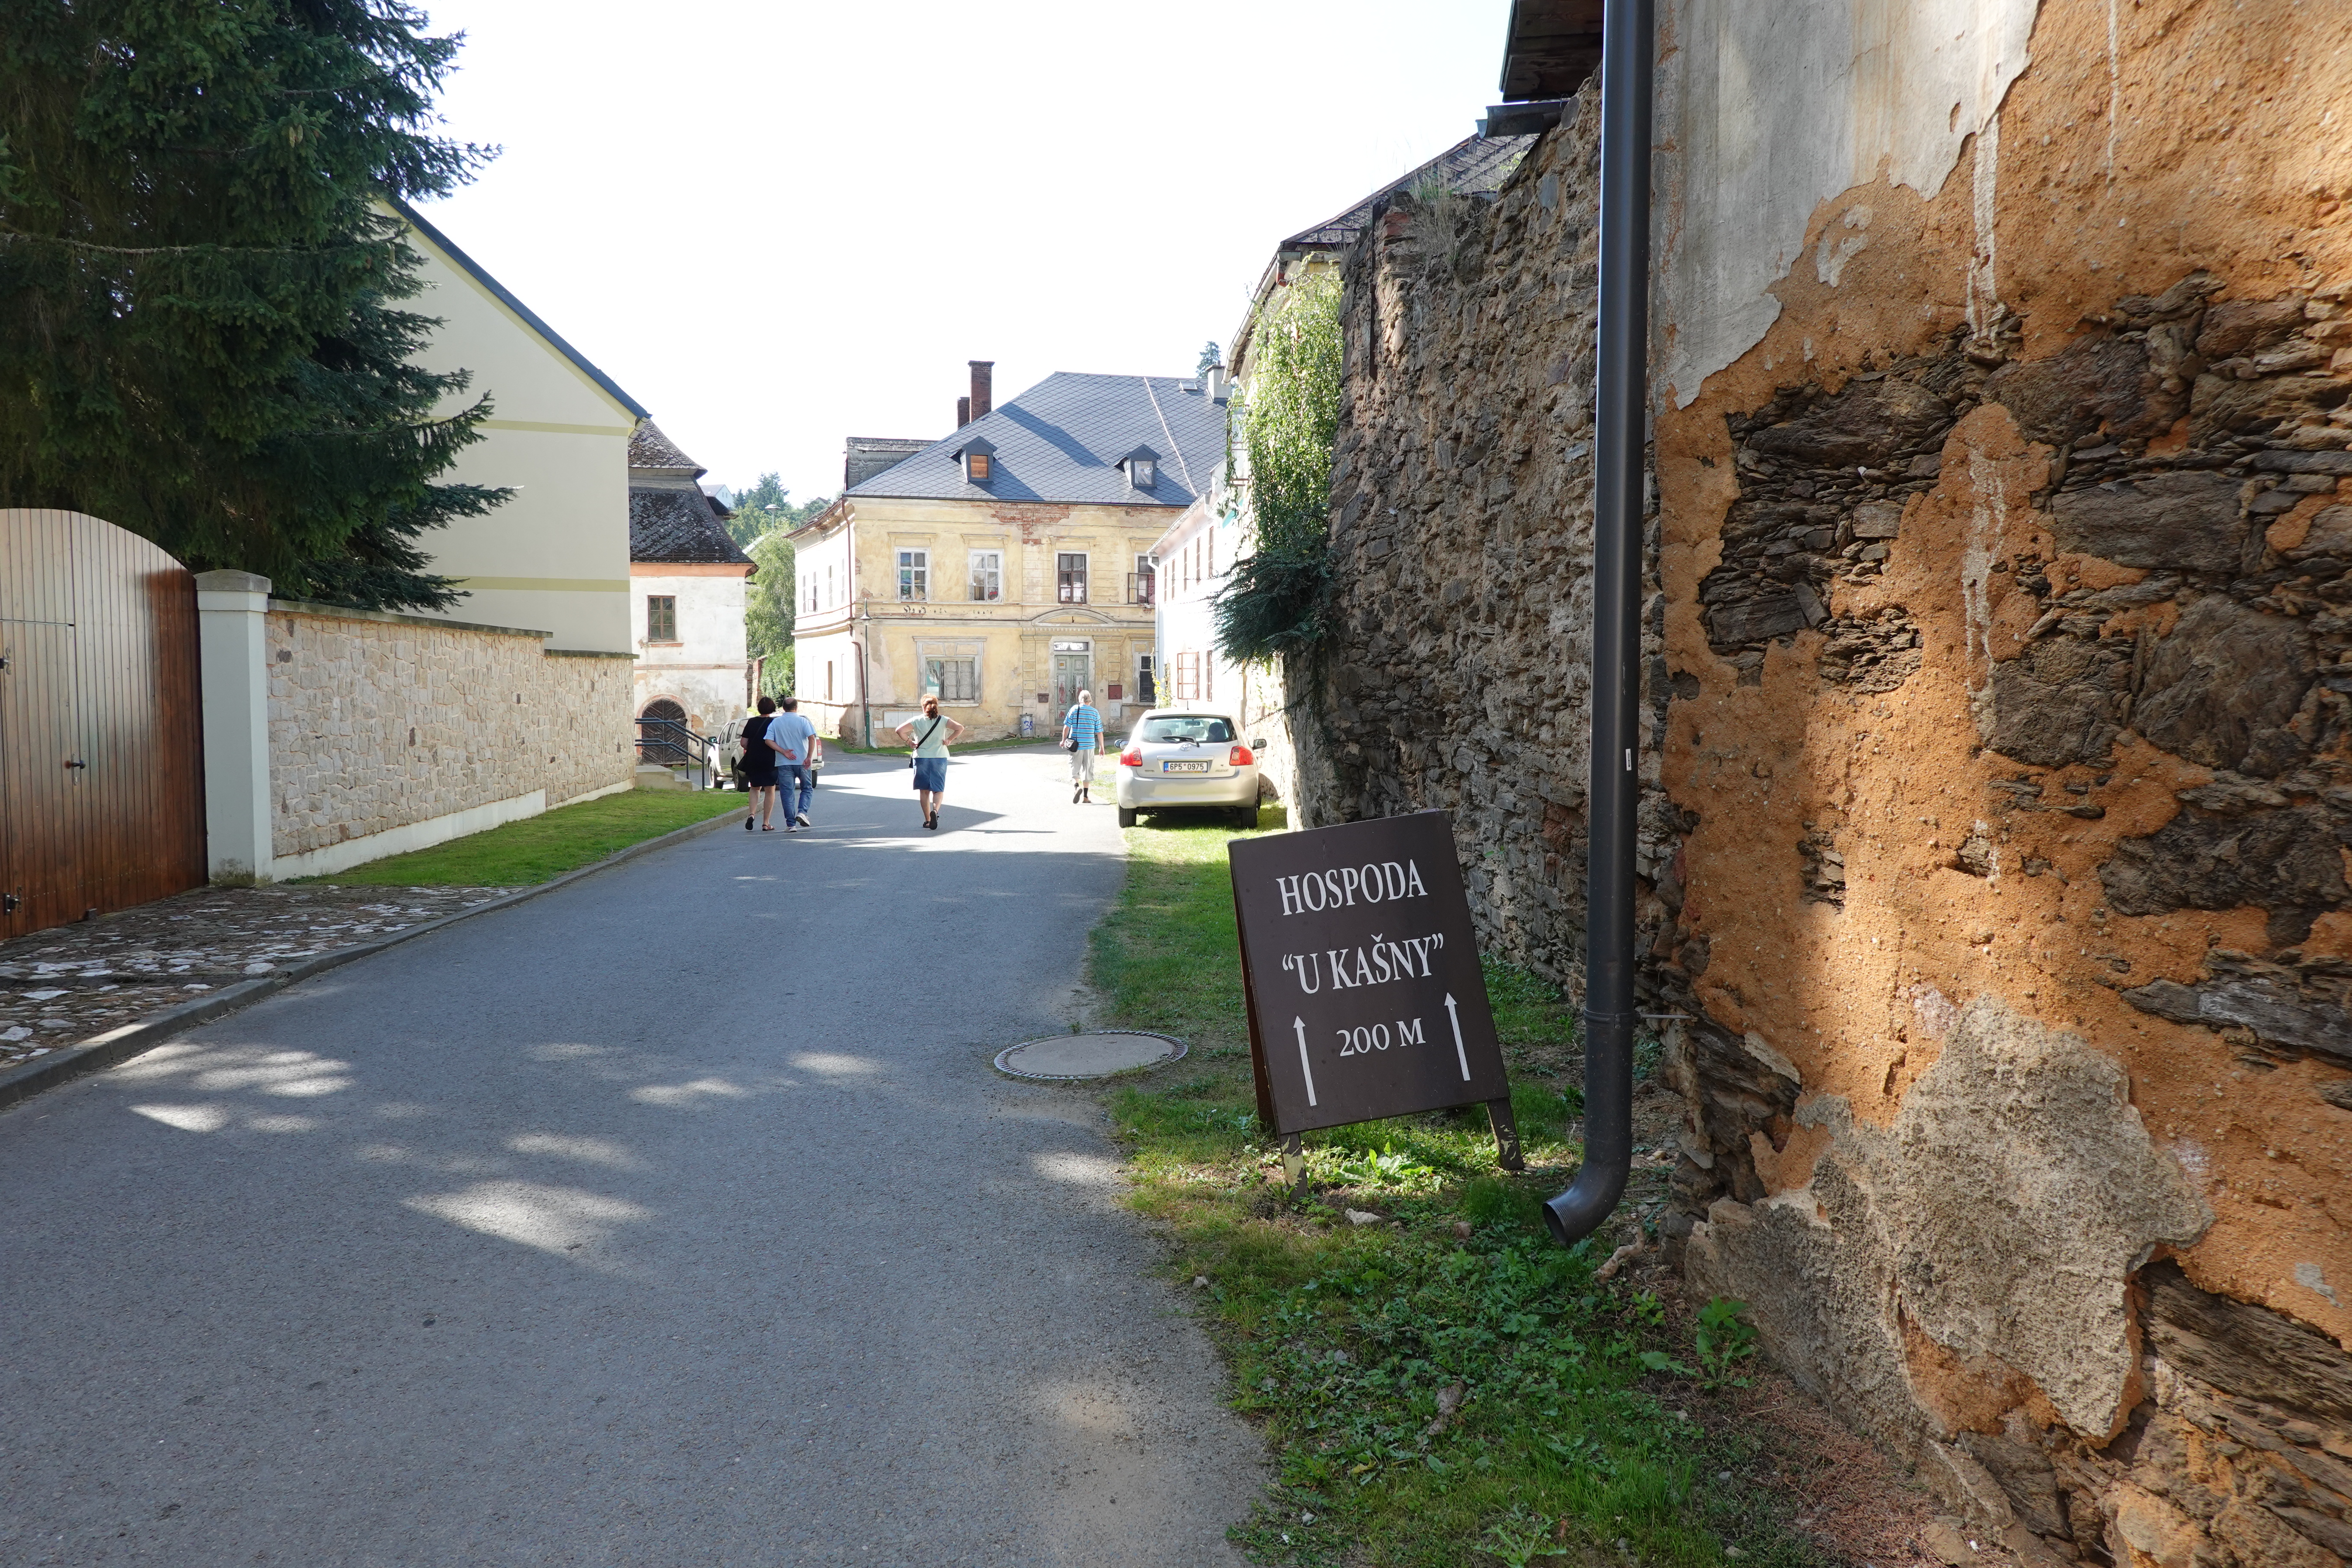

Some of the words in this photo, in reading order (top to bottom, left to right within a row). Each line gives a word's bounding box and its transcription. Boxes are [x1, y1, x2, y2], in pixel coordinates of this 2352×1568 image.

[1276, 859, 1427, 915] HOSPODA
[1337, 1024, 1389, 1056] 200
[1396, 1018, 1426, 1046] M
